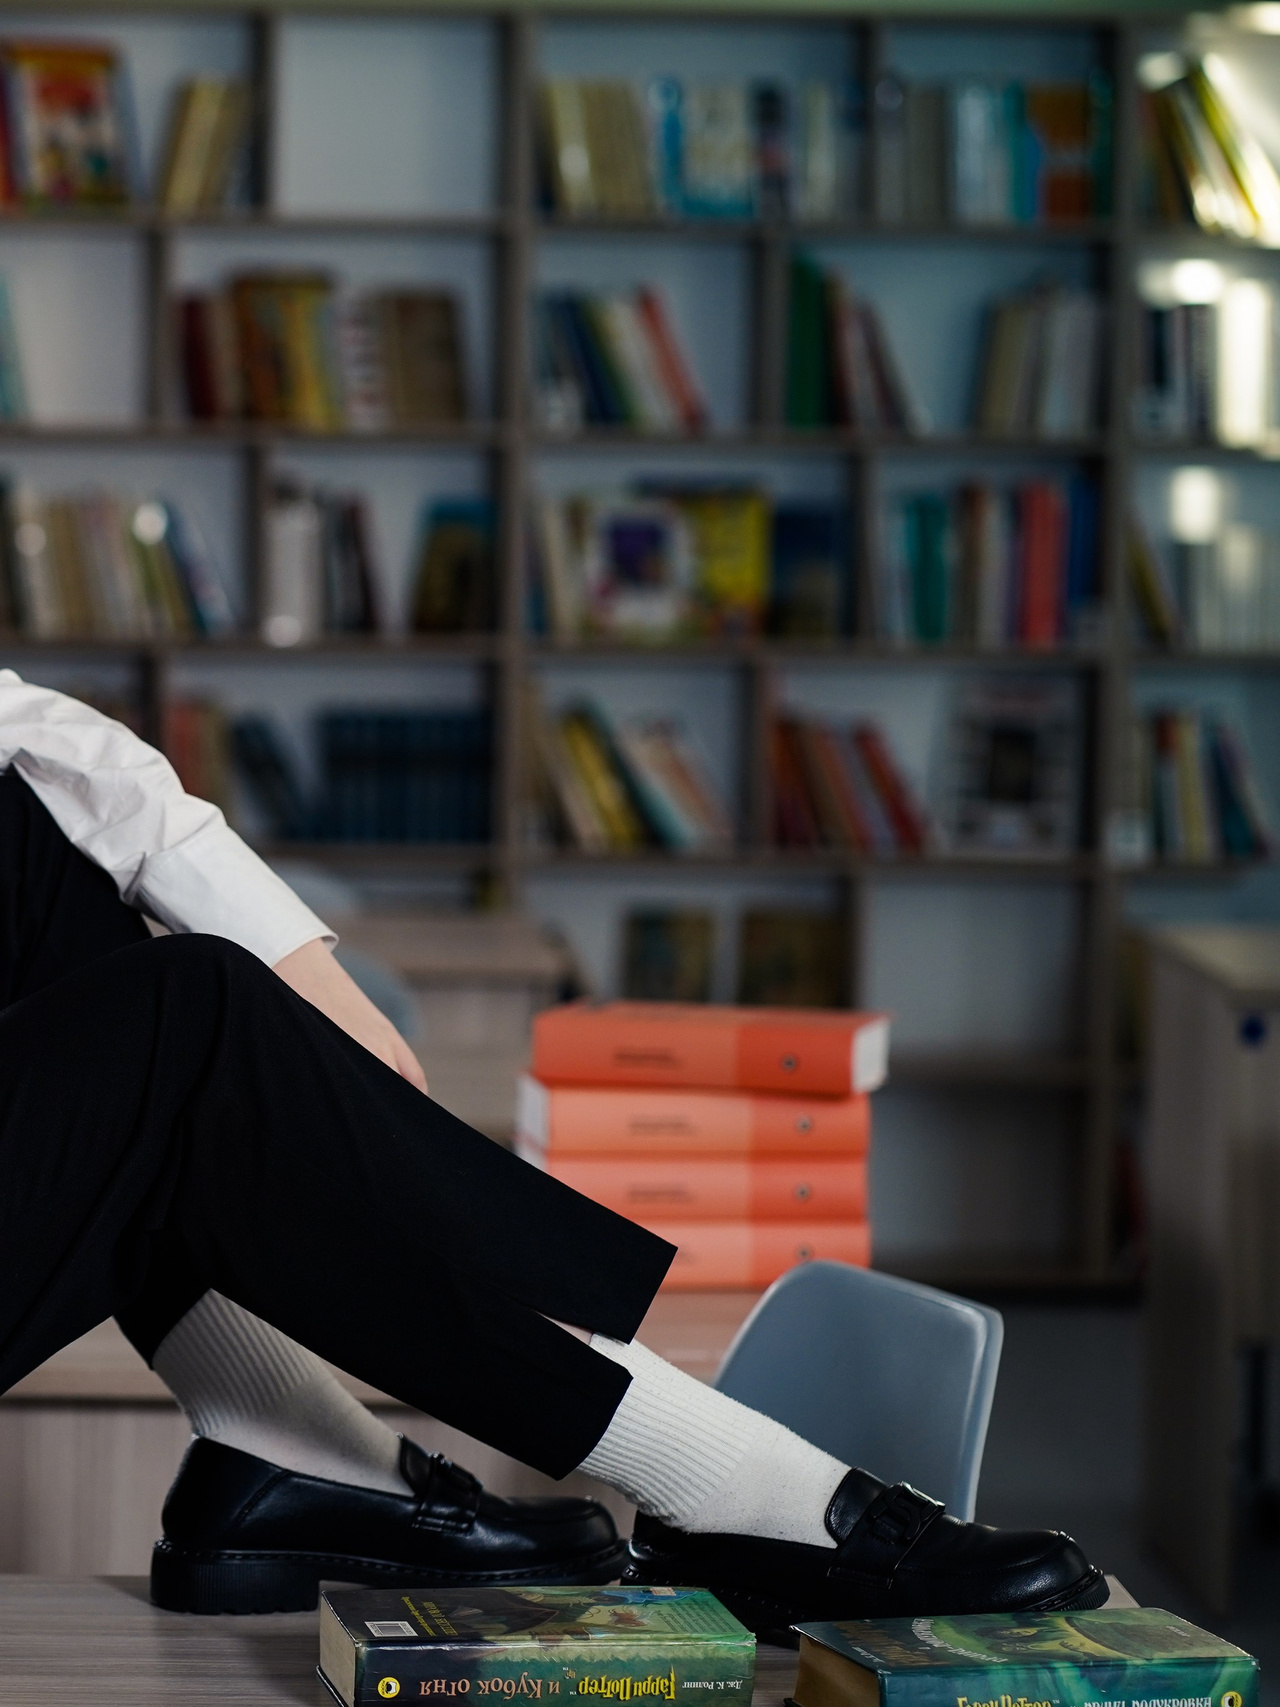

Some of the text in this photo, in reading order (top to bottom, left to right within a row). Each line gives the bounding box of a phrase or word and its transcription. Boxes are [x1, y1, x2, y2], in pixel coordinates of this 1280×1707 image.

[419, 1678, 471, 1696] огня
[477, 1671, 543, 1700] Кубок
[548, 1680, 560, 1694] и
[578, 1675, 633, 1701] Поттер
[634, 1664, 676, 1700] Гарри
[682, 1681, 714, 1690] Ролинг
